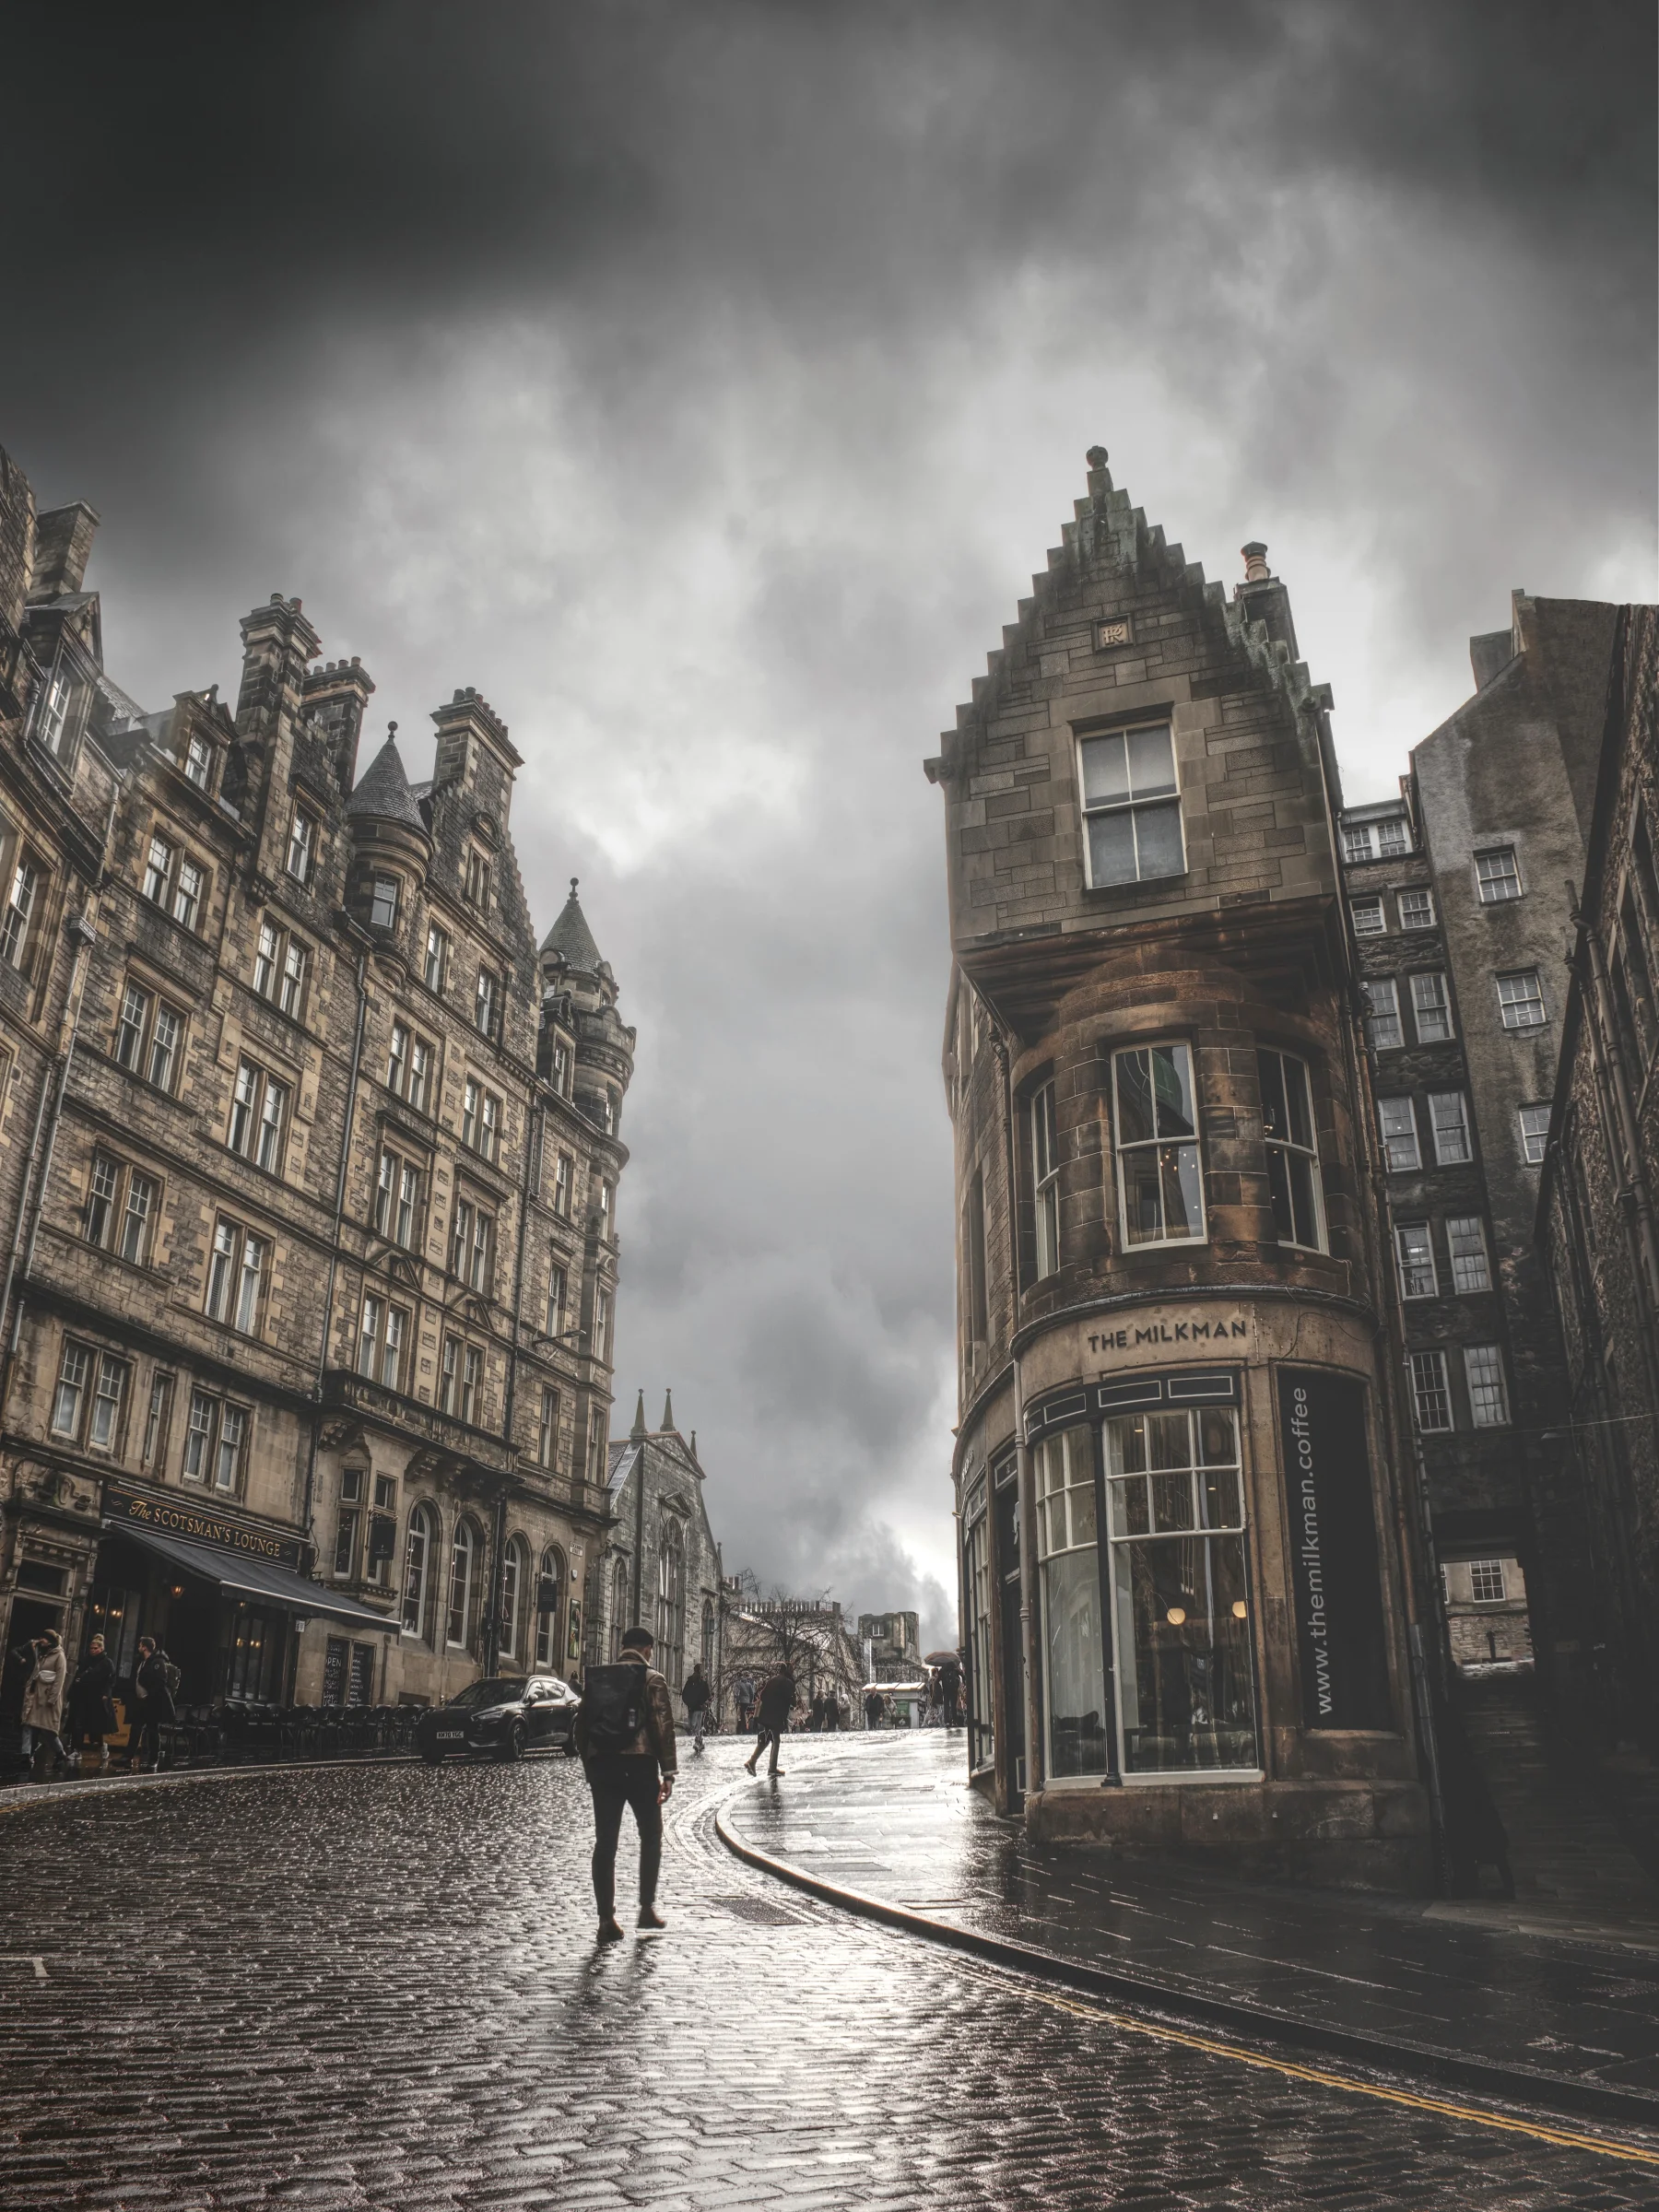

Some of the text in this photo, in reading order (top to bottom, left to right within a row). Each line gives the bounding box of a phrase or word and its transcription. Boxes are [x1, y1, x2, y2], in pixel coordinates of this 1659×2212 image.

[1088, 1320, 1247, 1353] THE MILKMAN
[129, 1500, 281, 1558] The SCOTSMAN'S LOUNGE
[1291, 1386, 1333, 1715] www.themilkman.coffee
